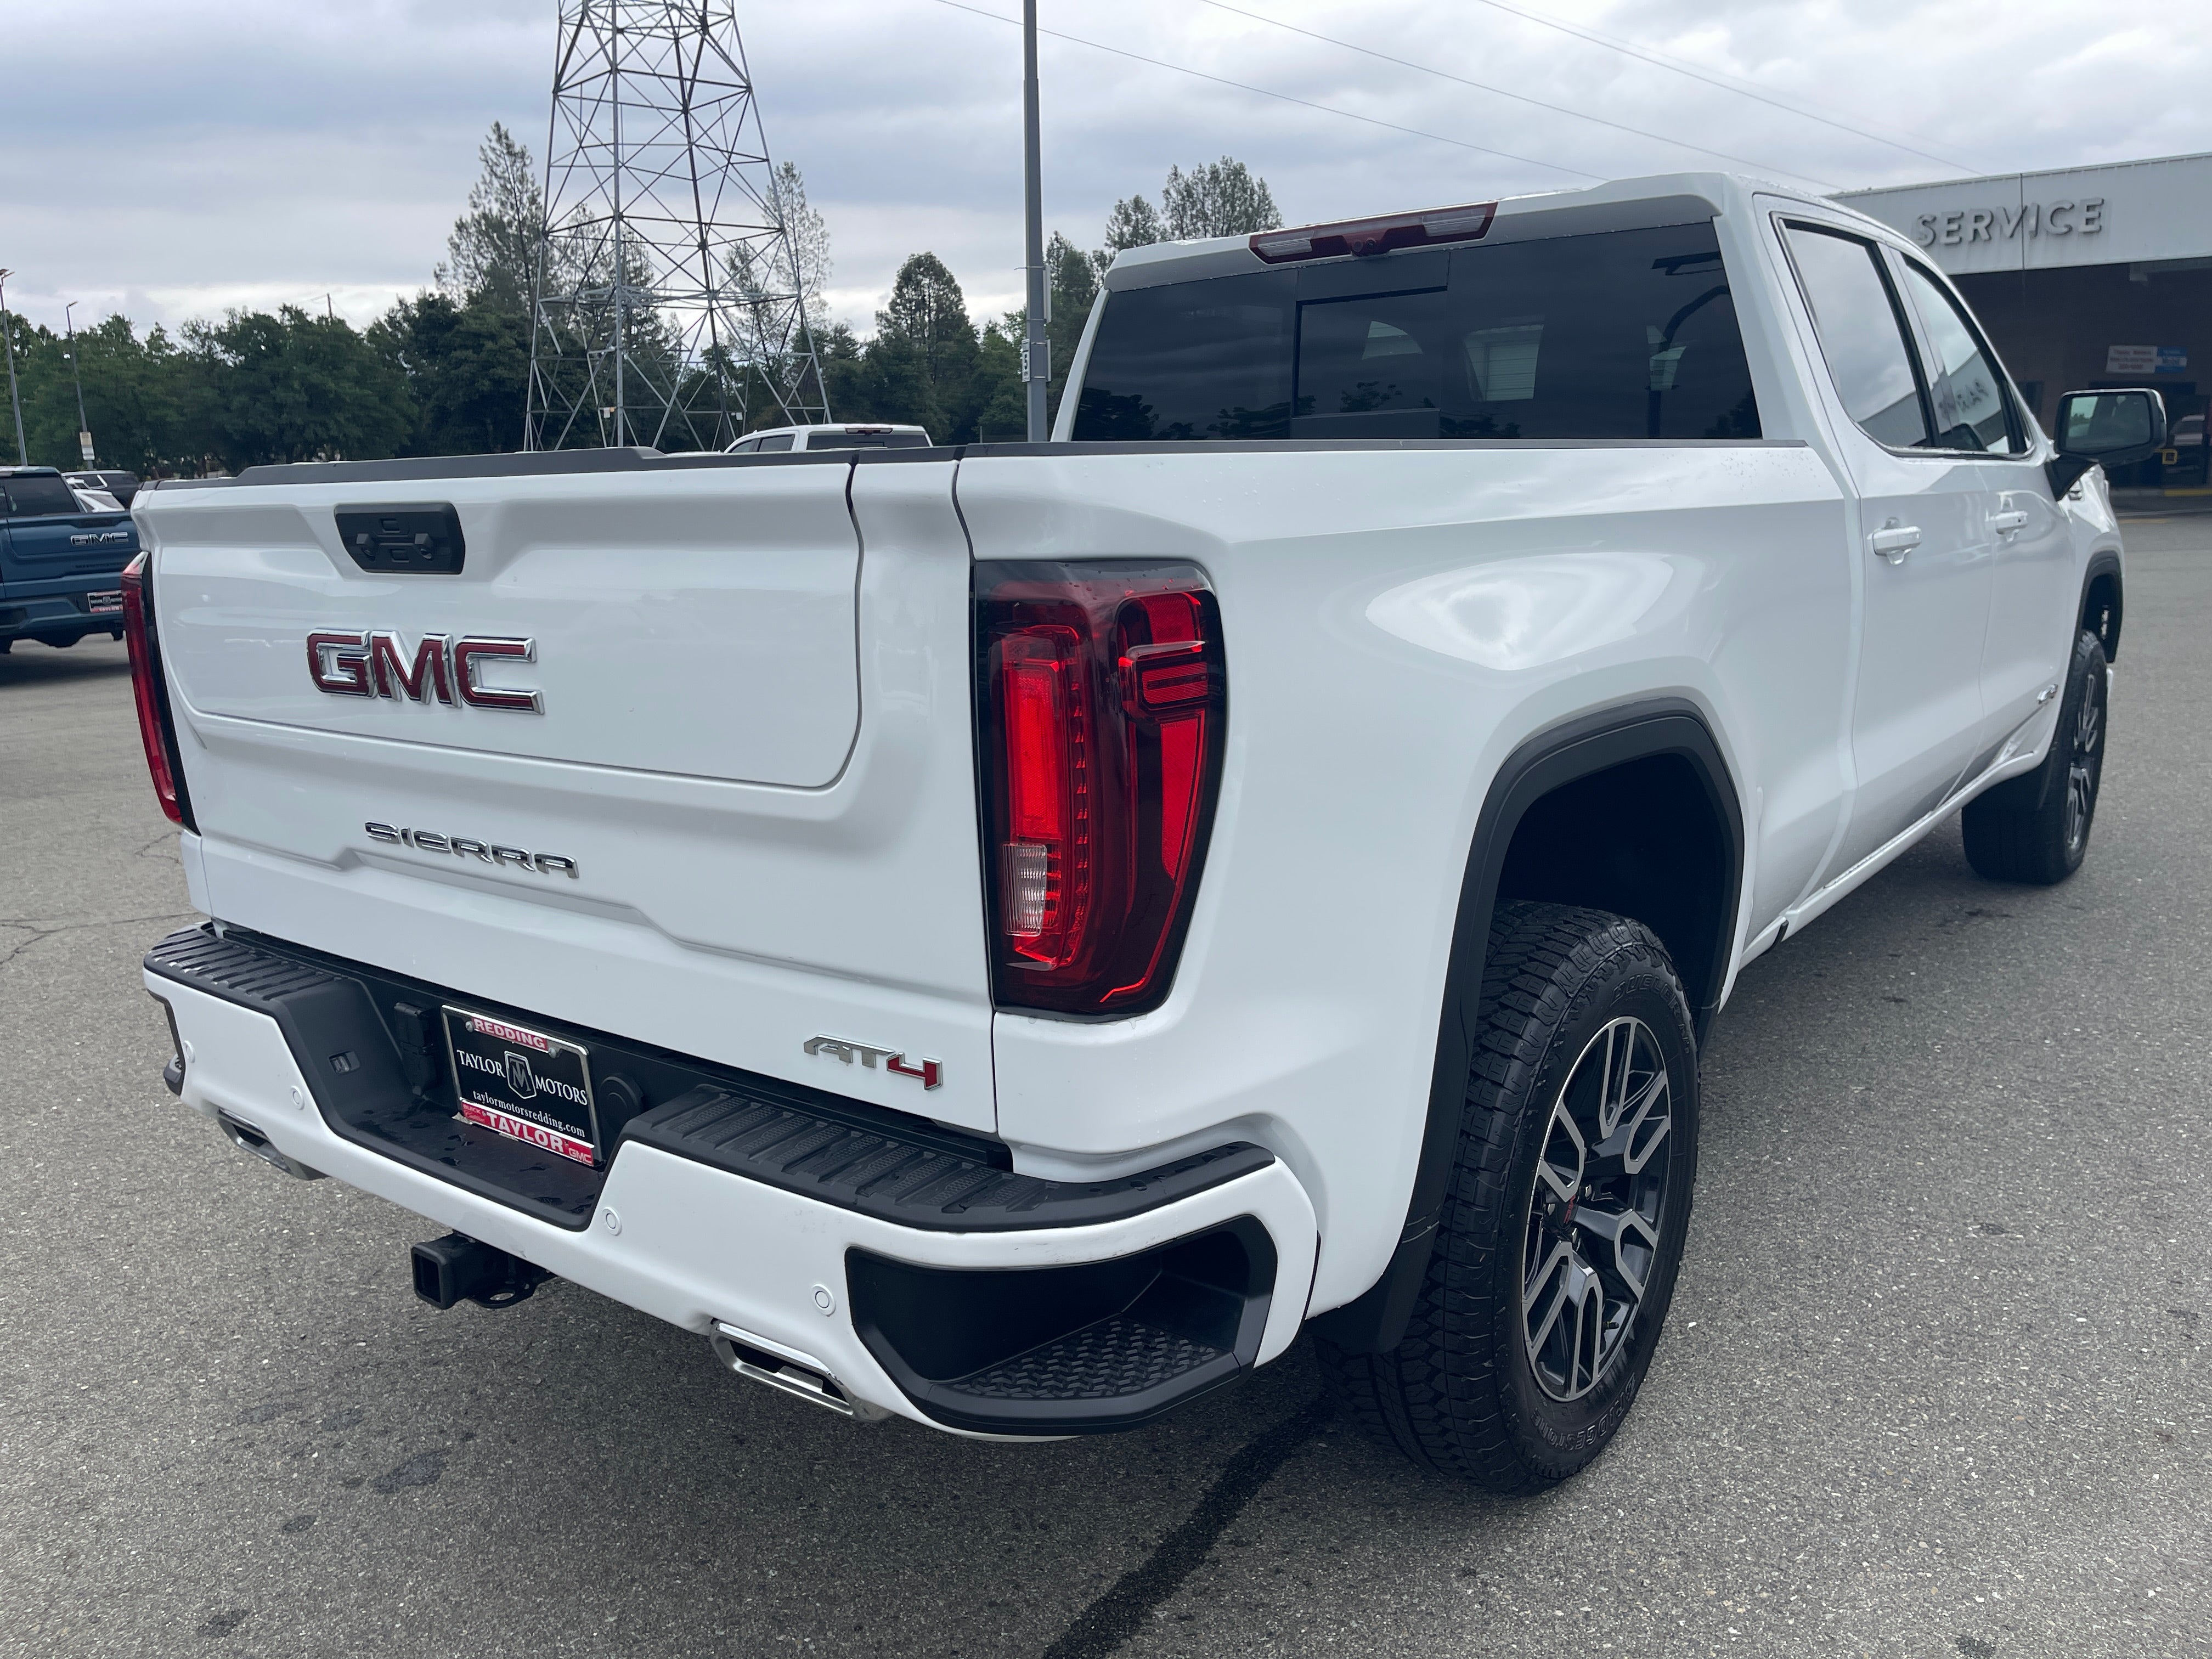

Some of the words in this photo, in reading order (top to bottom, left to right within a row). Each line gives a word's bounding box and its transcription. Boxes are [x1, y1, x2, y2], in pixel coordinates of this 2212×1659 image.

[1915, 197, 2104, 247] SERVICE
[70, 532, 129, 546] GMC
[306, 628, 545, 715] GMC
[364, 821, 579, 878] SIERRA
[473, 1018, 546, 1049] REDDING
[456, 1049, 506, 1078] TAYLOR
[535, 1074, 588, 1105] MOTORS
[803, 1034, 944, 1091] AT4
[473, 1090, 585, 1138] taylormotorsredding.com
[486, 1111, 565, 1153] TAYLOR
[568, 1148, 592, 1164] GMC
